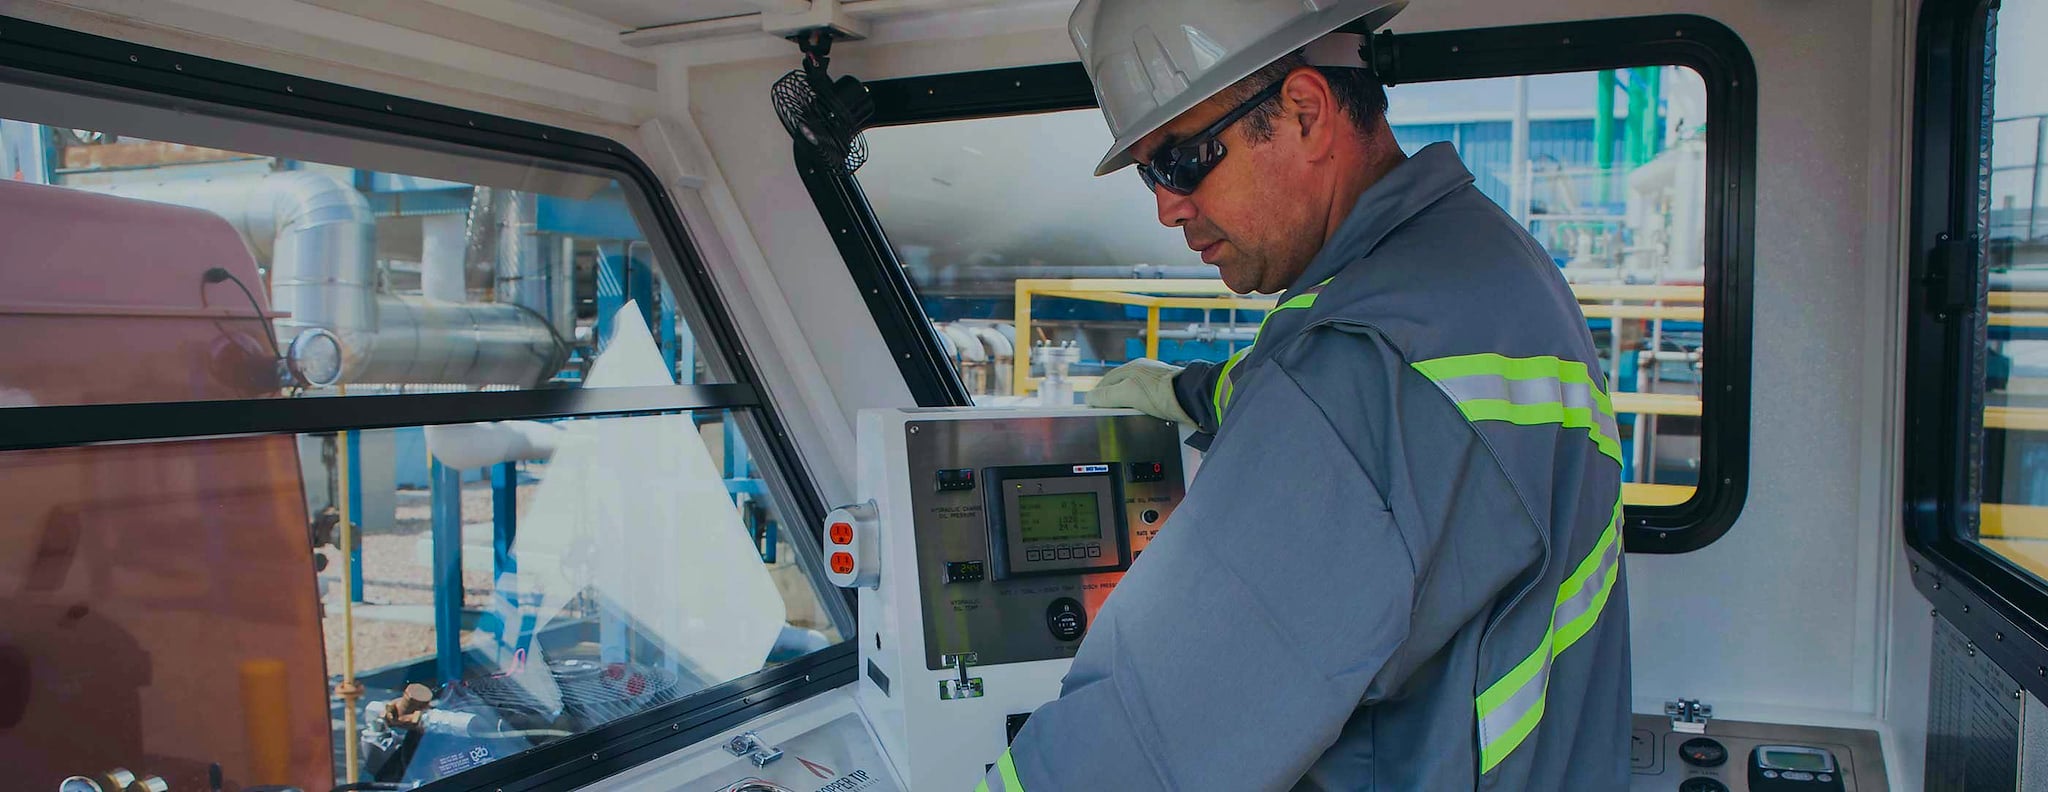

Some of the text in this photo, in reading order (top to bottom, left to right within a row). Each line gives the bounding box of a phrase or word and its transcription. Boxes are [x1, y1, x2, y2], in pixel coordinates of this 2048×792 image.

[1153, 463, 1161, 474] 0
[815, 769, 870, 792] OPPER TIP
